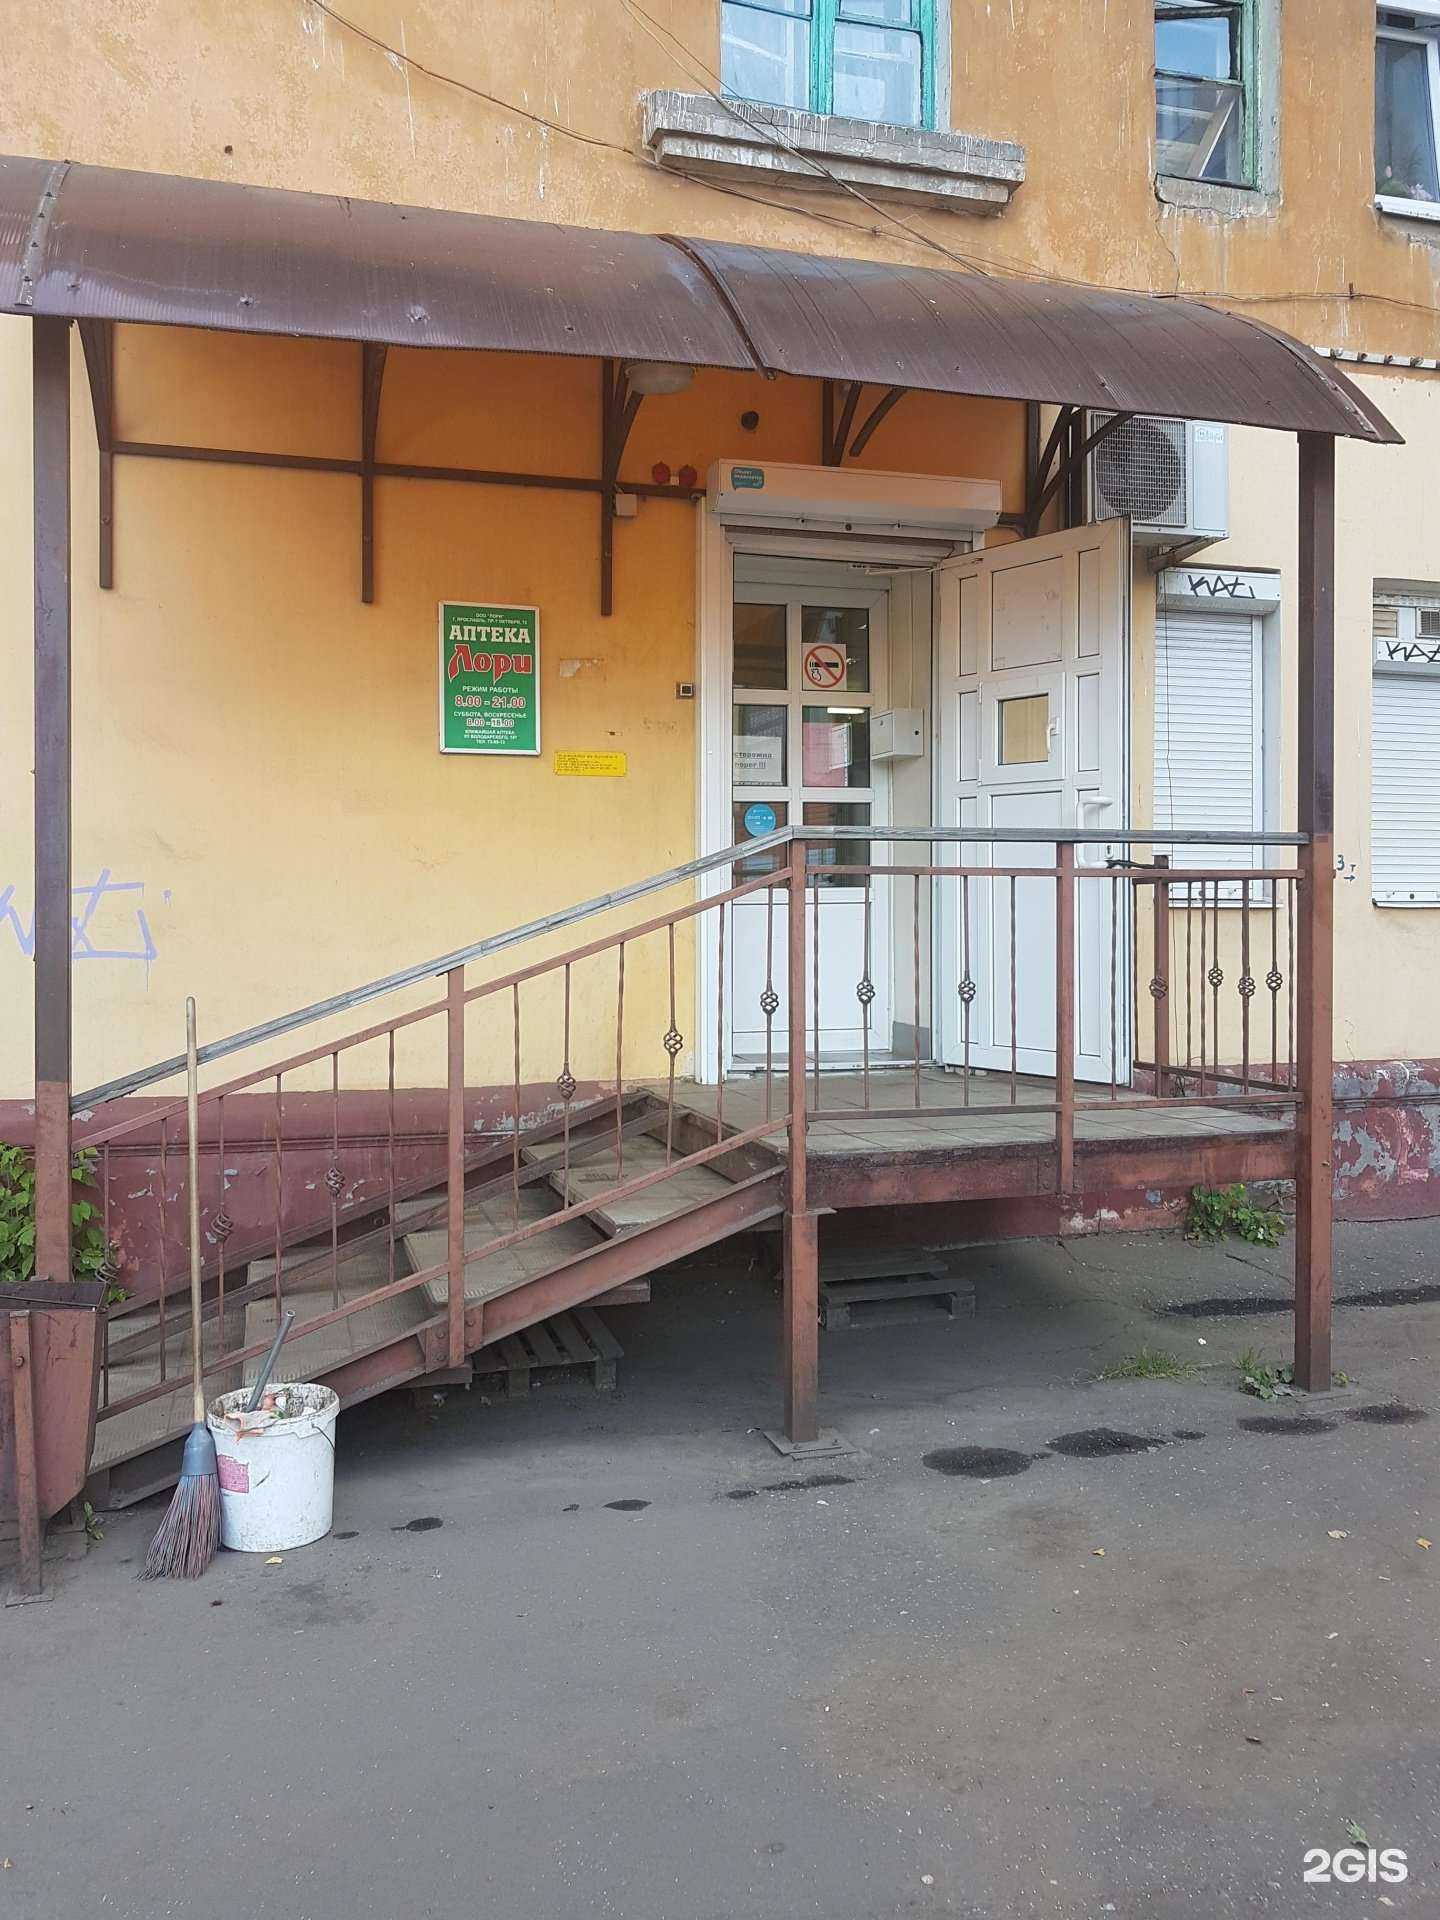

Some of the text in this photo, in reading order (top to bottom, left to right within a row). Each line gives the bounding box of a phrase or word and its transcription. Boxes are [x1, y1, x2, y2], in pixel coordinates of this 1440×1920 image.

[449, 624, 531, 644] АПТЕКА
[448, 643, 533, 685] Лори
[462, 685, 519, 694] РЕЖИМ РАБОТЫ
[455, 694, 482, 708] 8.00
[491, 696, 526, 709] 21.00
[466, 717, 485, 727] 8.00
